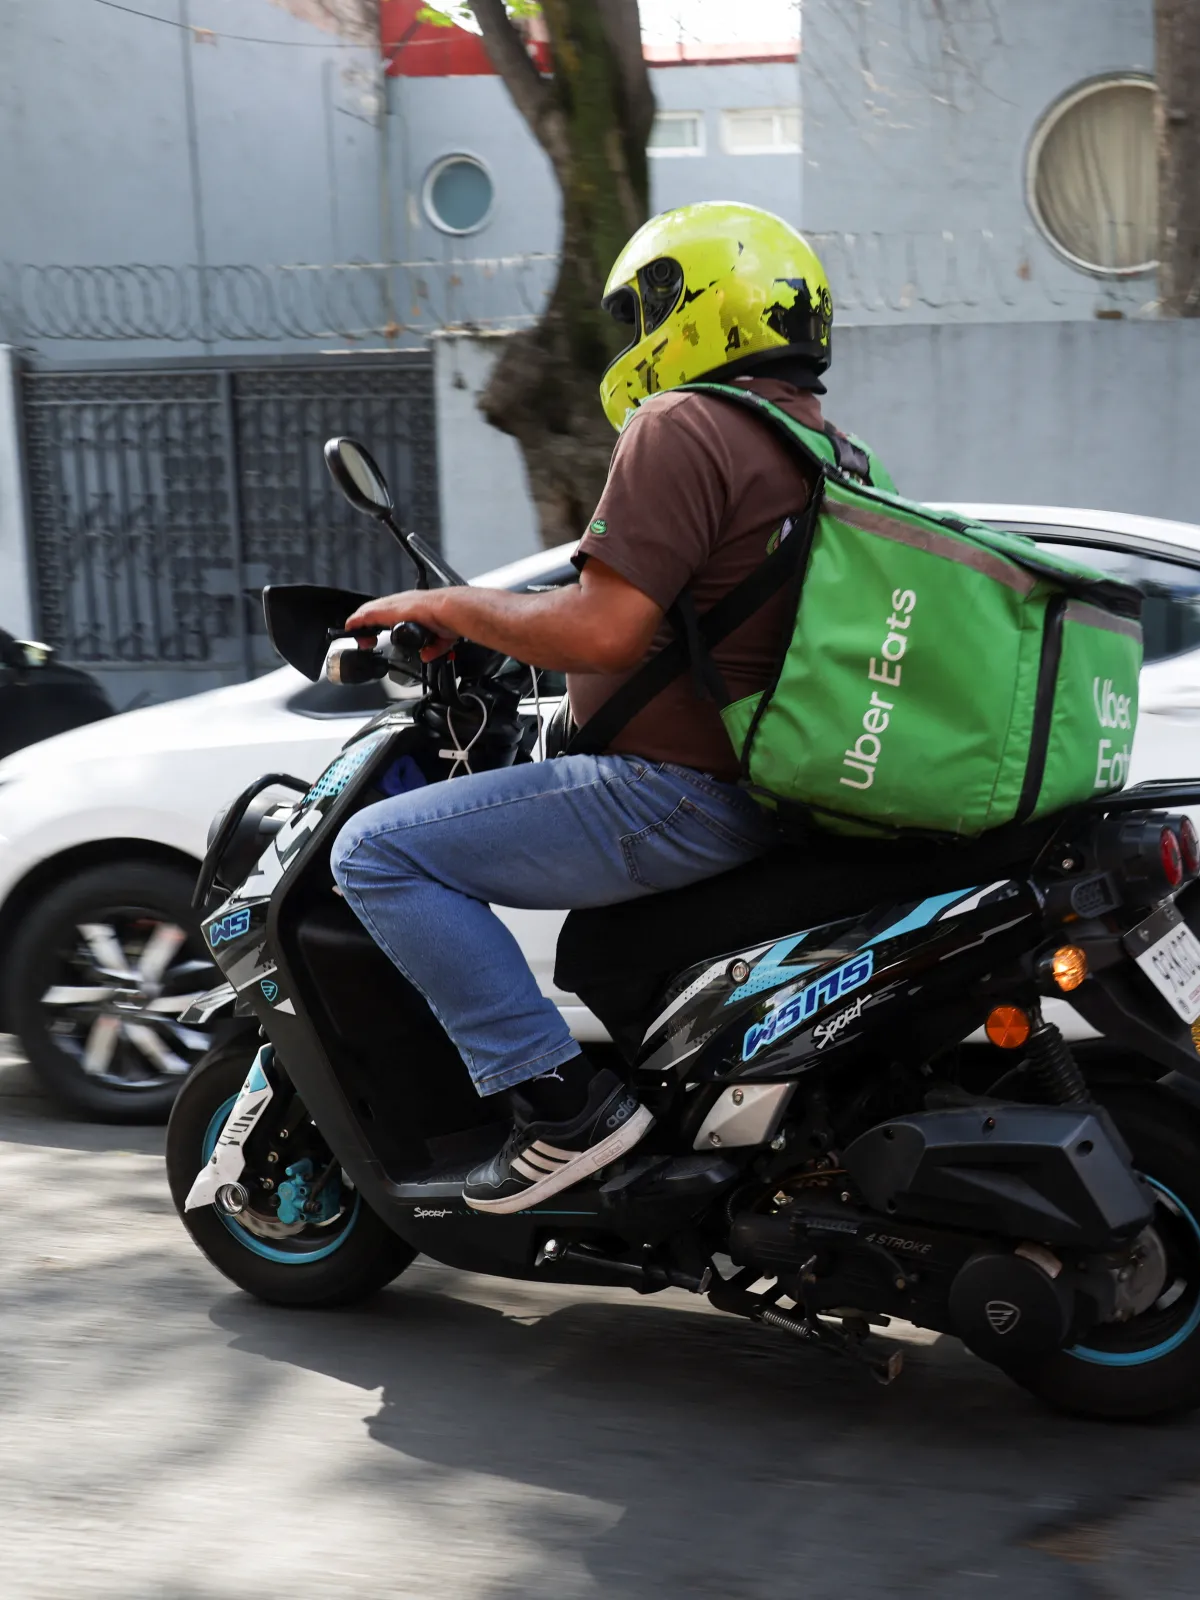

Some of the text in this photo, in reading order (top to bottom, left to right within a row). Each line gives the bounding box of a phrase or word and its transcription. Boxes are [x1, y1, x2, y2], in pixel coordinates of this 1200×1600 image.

[840, 588, 917, 790] Uber Eats
[1093, 676, 1131, 730] Uber
[210, 908, 251, 947] WS
[865, 1233, 932, 1254] 4 STROKE
